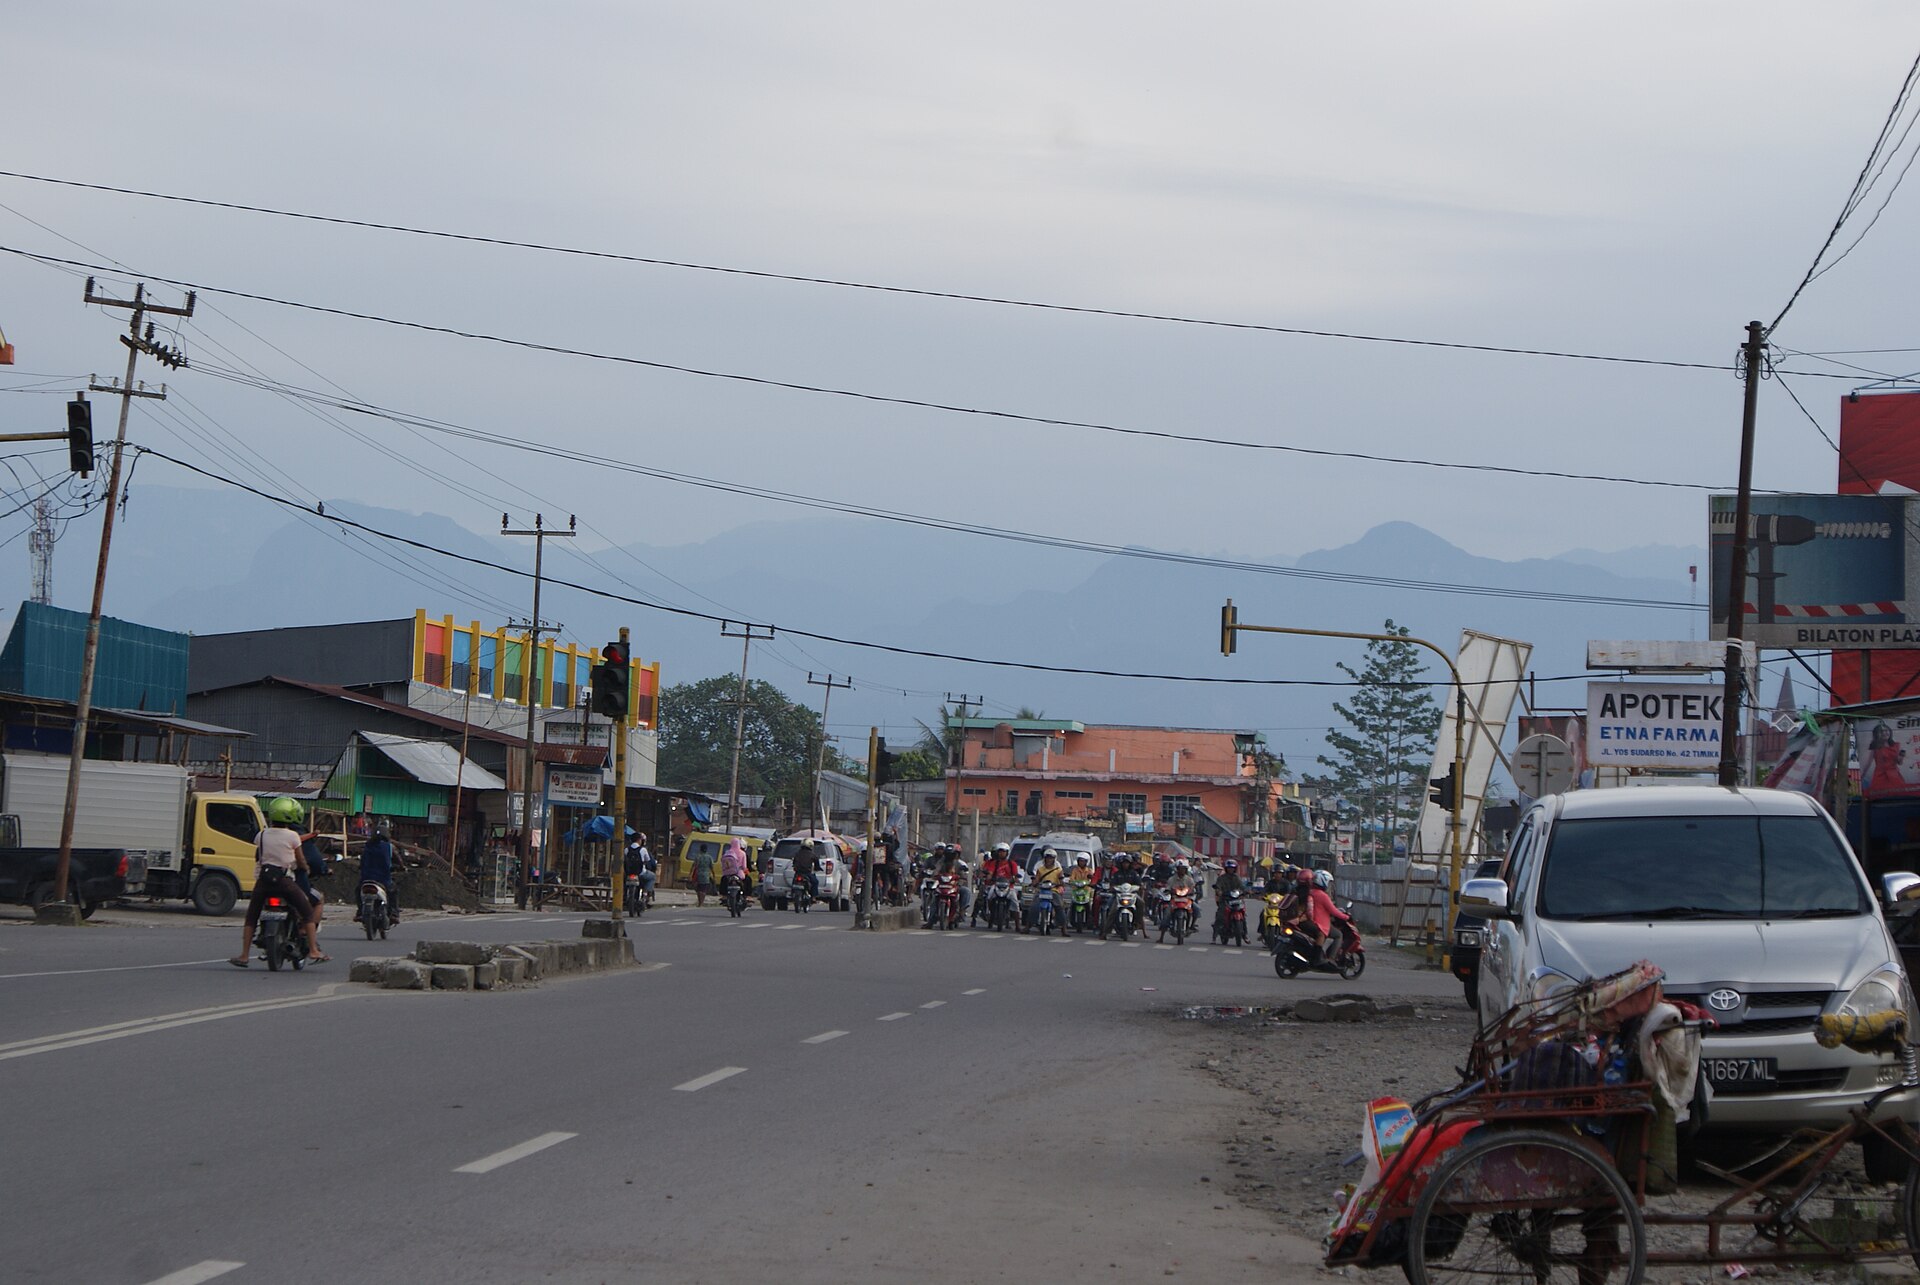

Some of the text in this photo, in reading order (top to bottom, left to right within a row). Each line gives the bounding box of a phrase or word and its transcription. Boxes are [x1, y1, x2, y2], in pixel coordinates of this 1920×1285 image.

[1797, 629, 1875, 643] BILATON
[1600, 693, 1723, 721] APOTEK
[1600, 726, 1720, 742] ETNA FARMA
[1614, 748, 1629, 756] YOS
[1630, 749, 1665, 757] SUDARSO
[1680, 750, 1691, 758] 42
[1693, 750, 1720, 758] TIMIKA
[1709, 1060, 1750, 1080] 1667
[1753, 1060, 1776, 1080] ML
